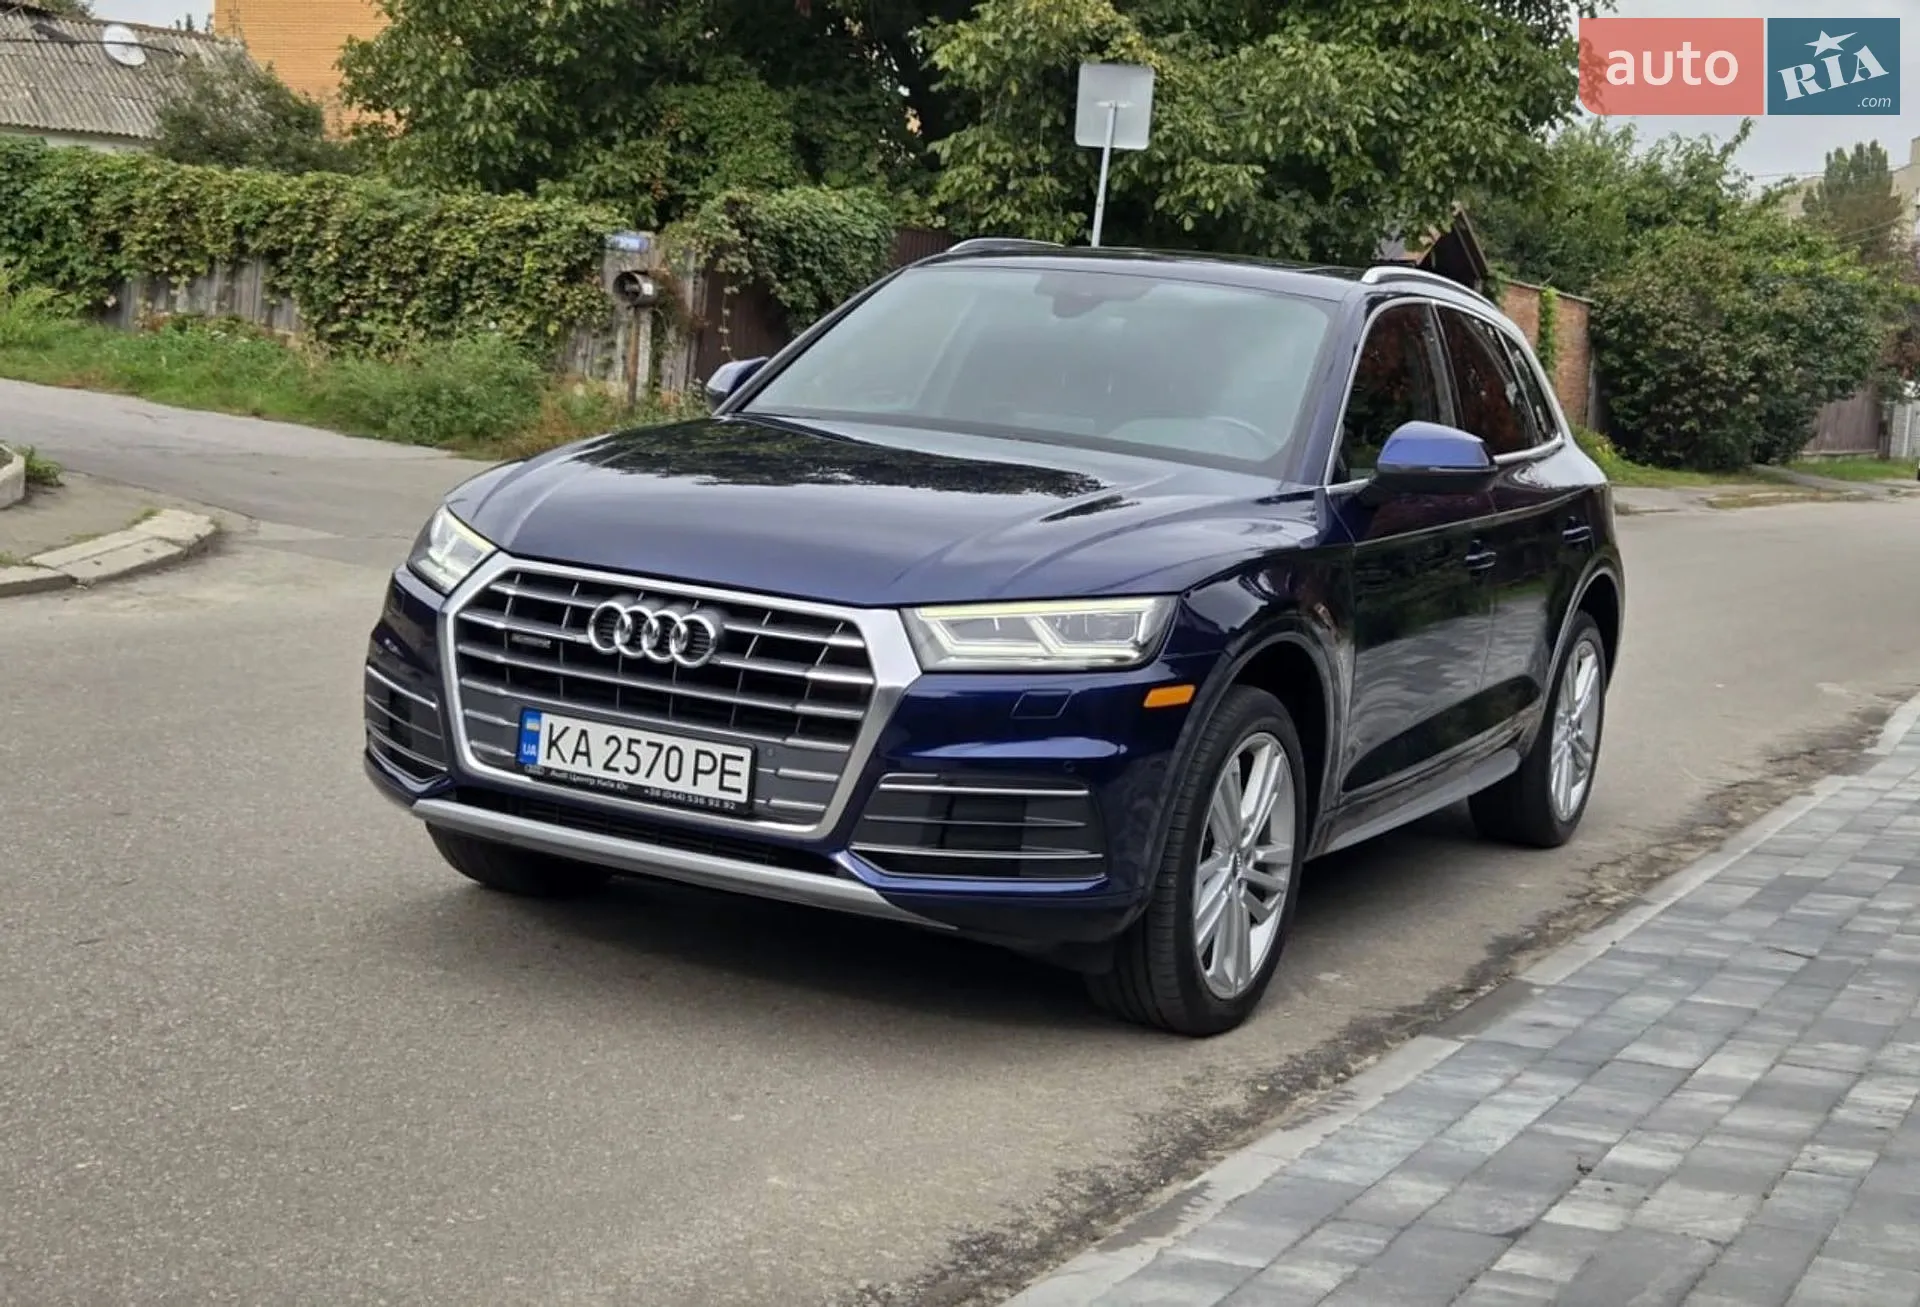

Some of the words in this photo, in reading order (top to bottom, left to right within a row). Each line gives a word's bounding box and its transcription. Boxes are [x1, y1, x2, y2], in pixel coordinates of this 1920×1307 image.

[523, 743, 537, 756] UA
[546, 723, 592, 768] KA
[603, 735, 684, 783] 2570
[693, 748, 744, 794] PE
